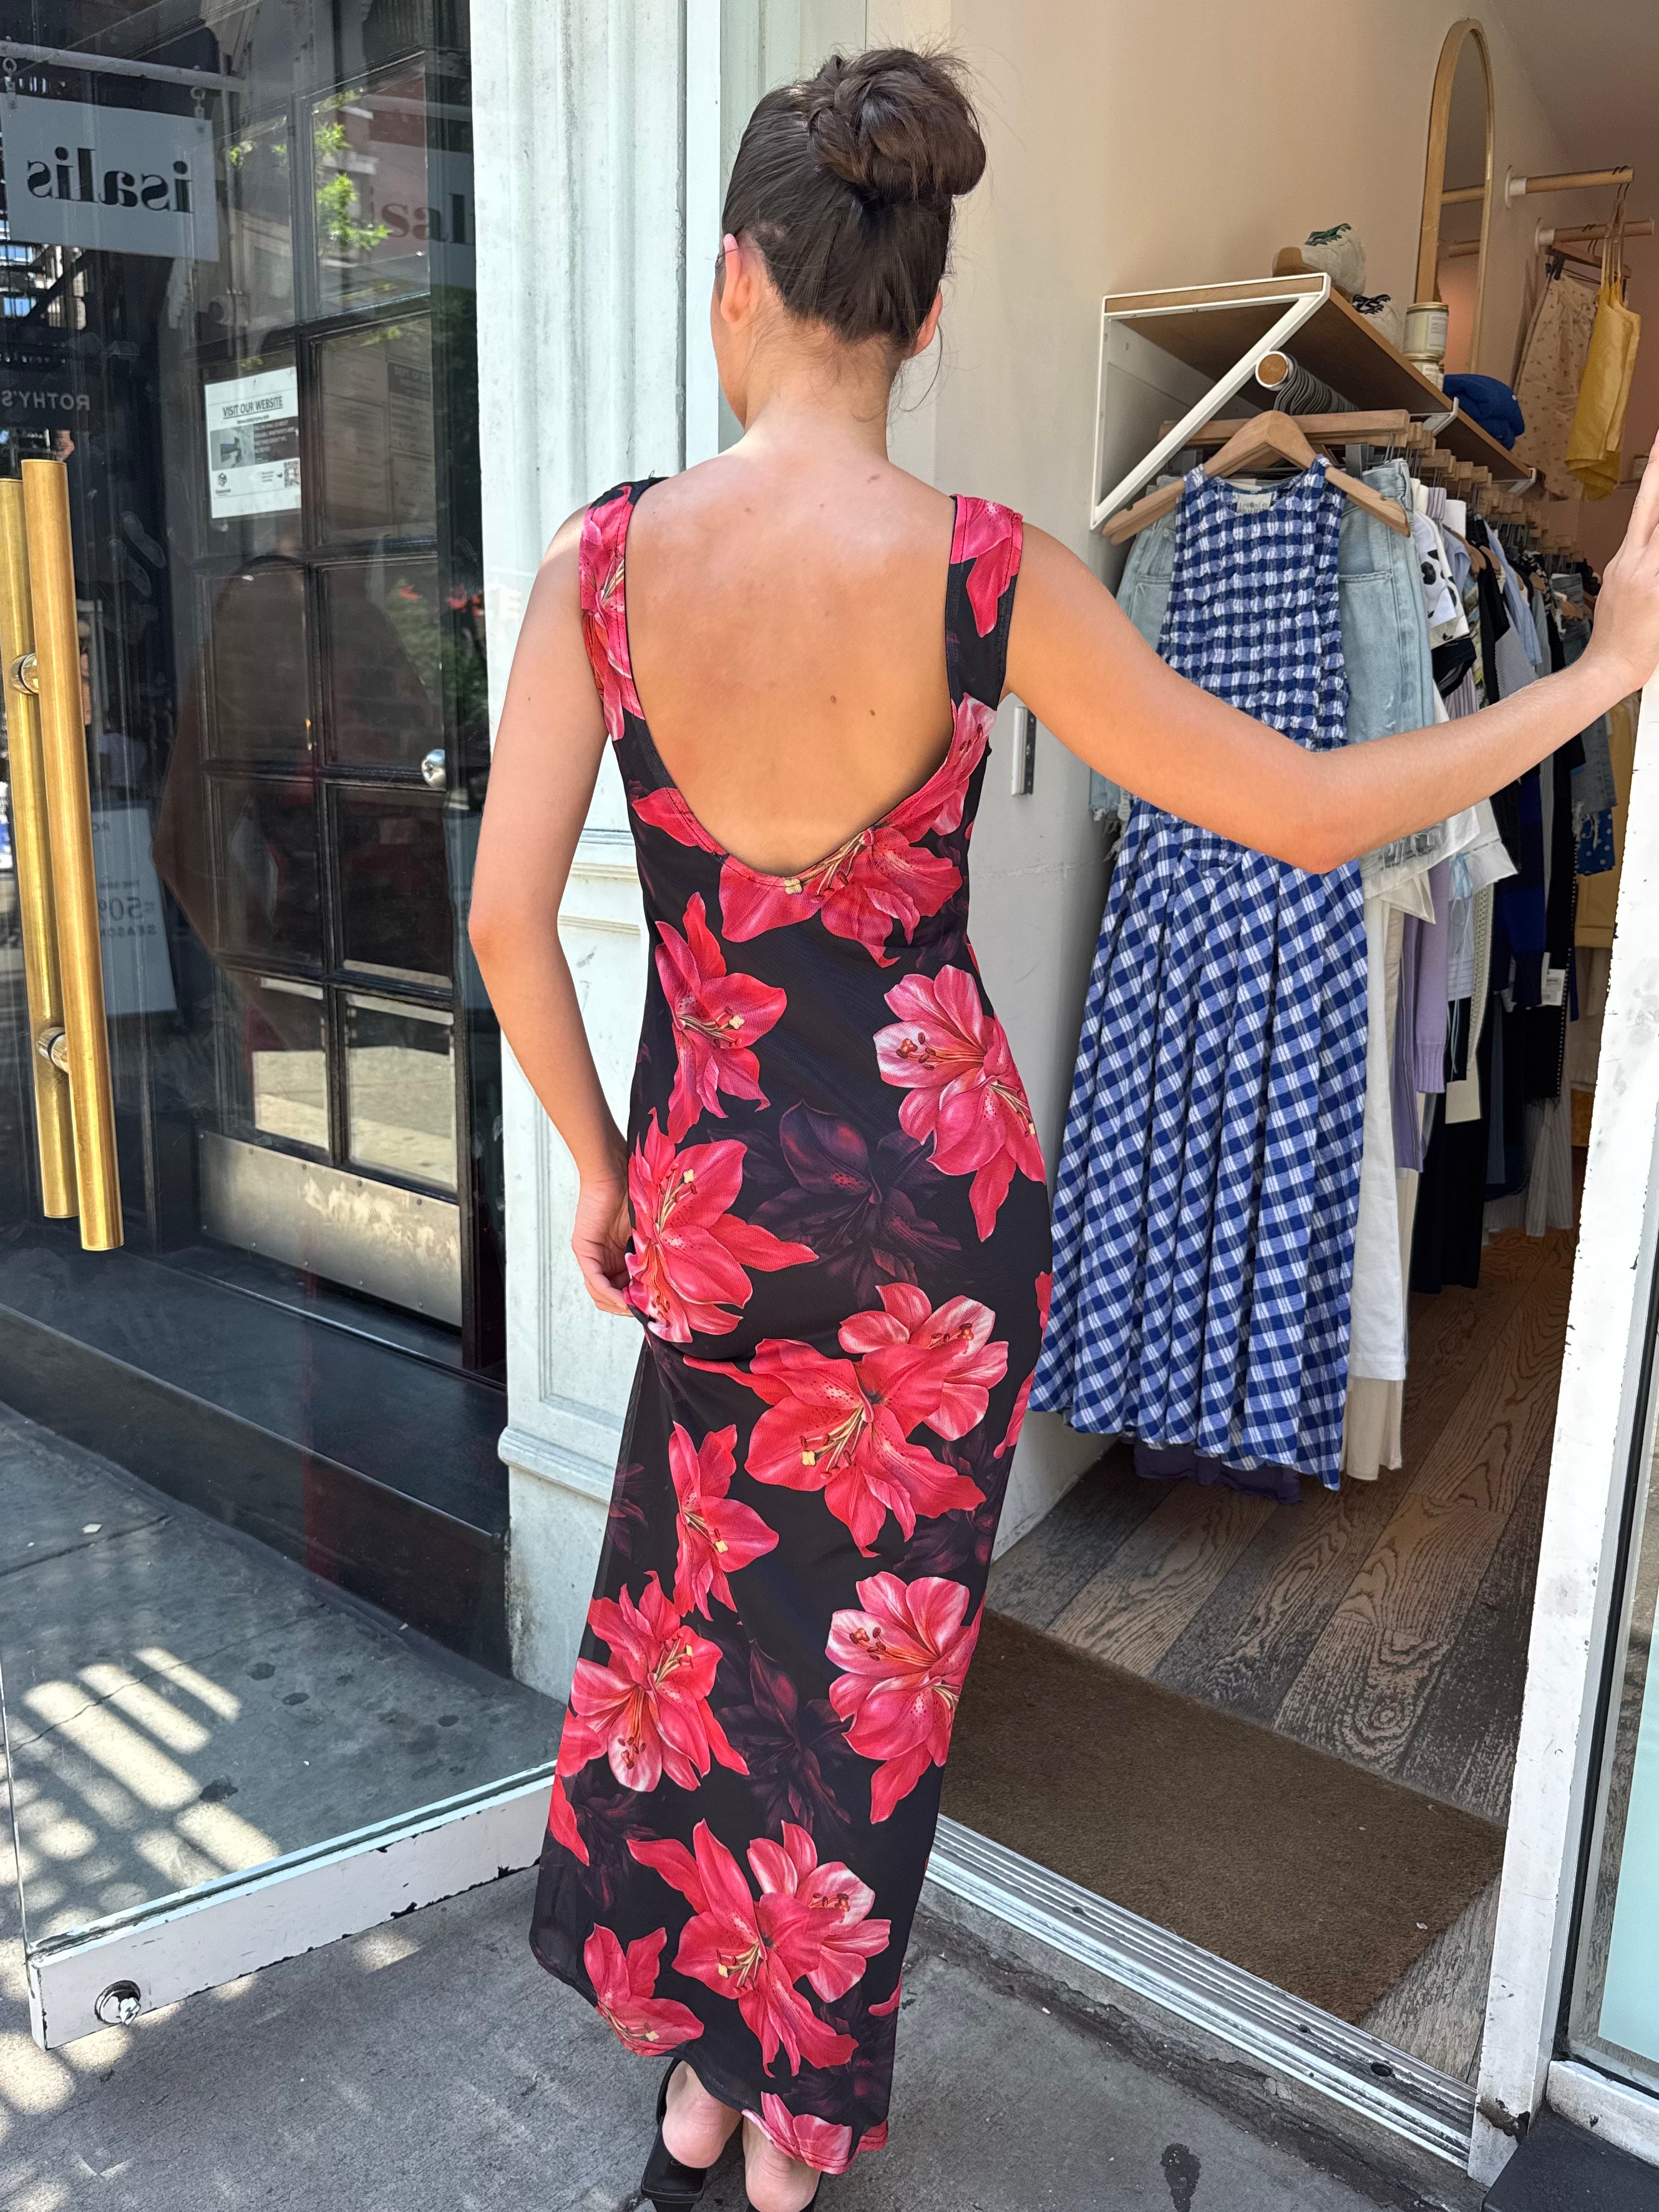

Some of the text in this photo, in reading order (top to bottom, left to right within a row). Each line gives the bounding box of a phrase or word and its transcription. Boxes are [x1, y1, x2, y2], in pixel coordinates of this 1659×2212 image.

[223, 396, 283, 417] VISIT OUR WEBSITE
